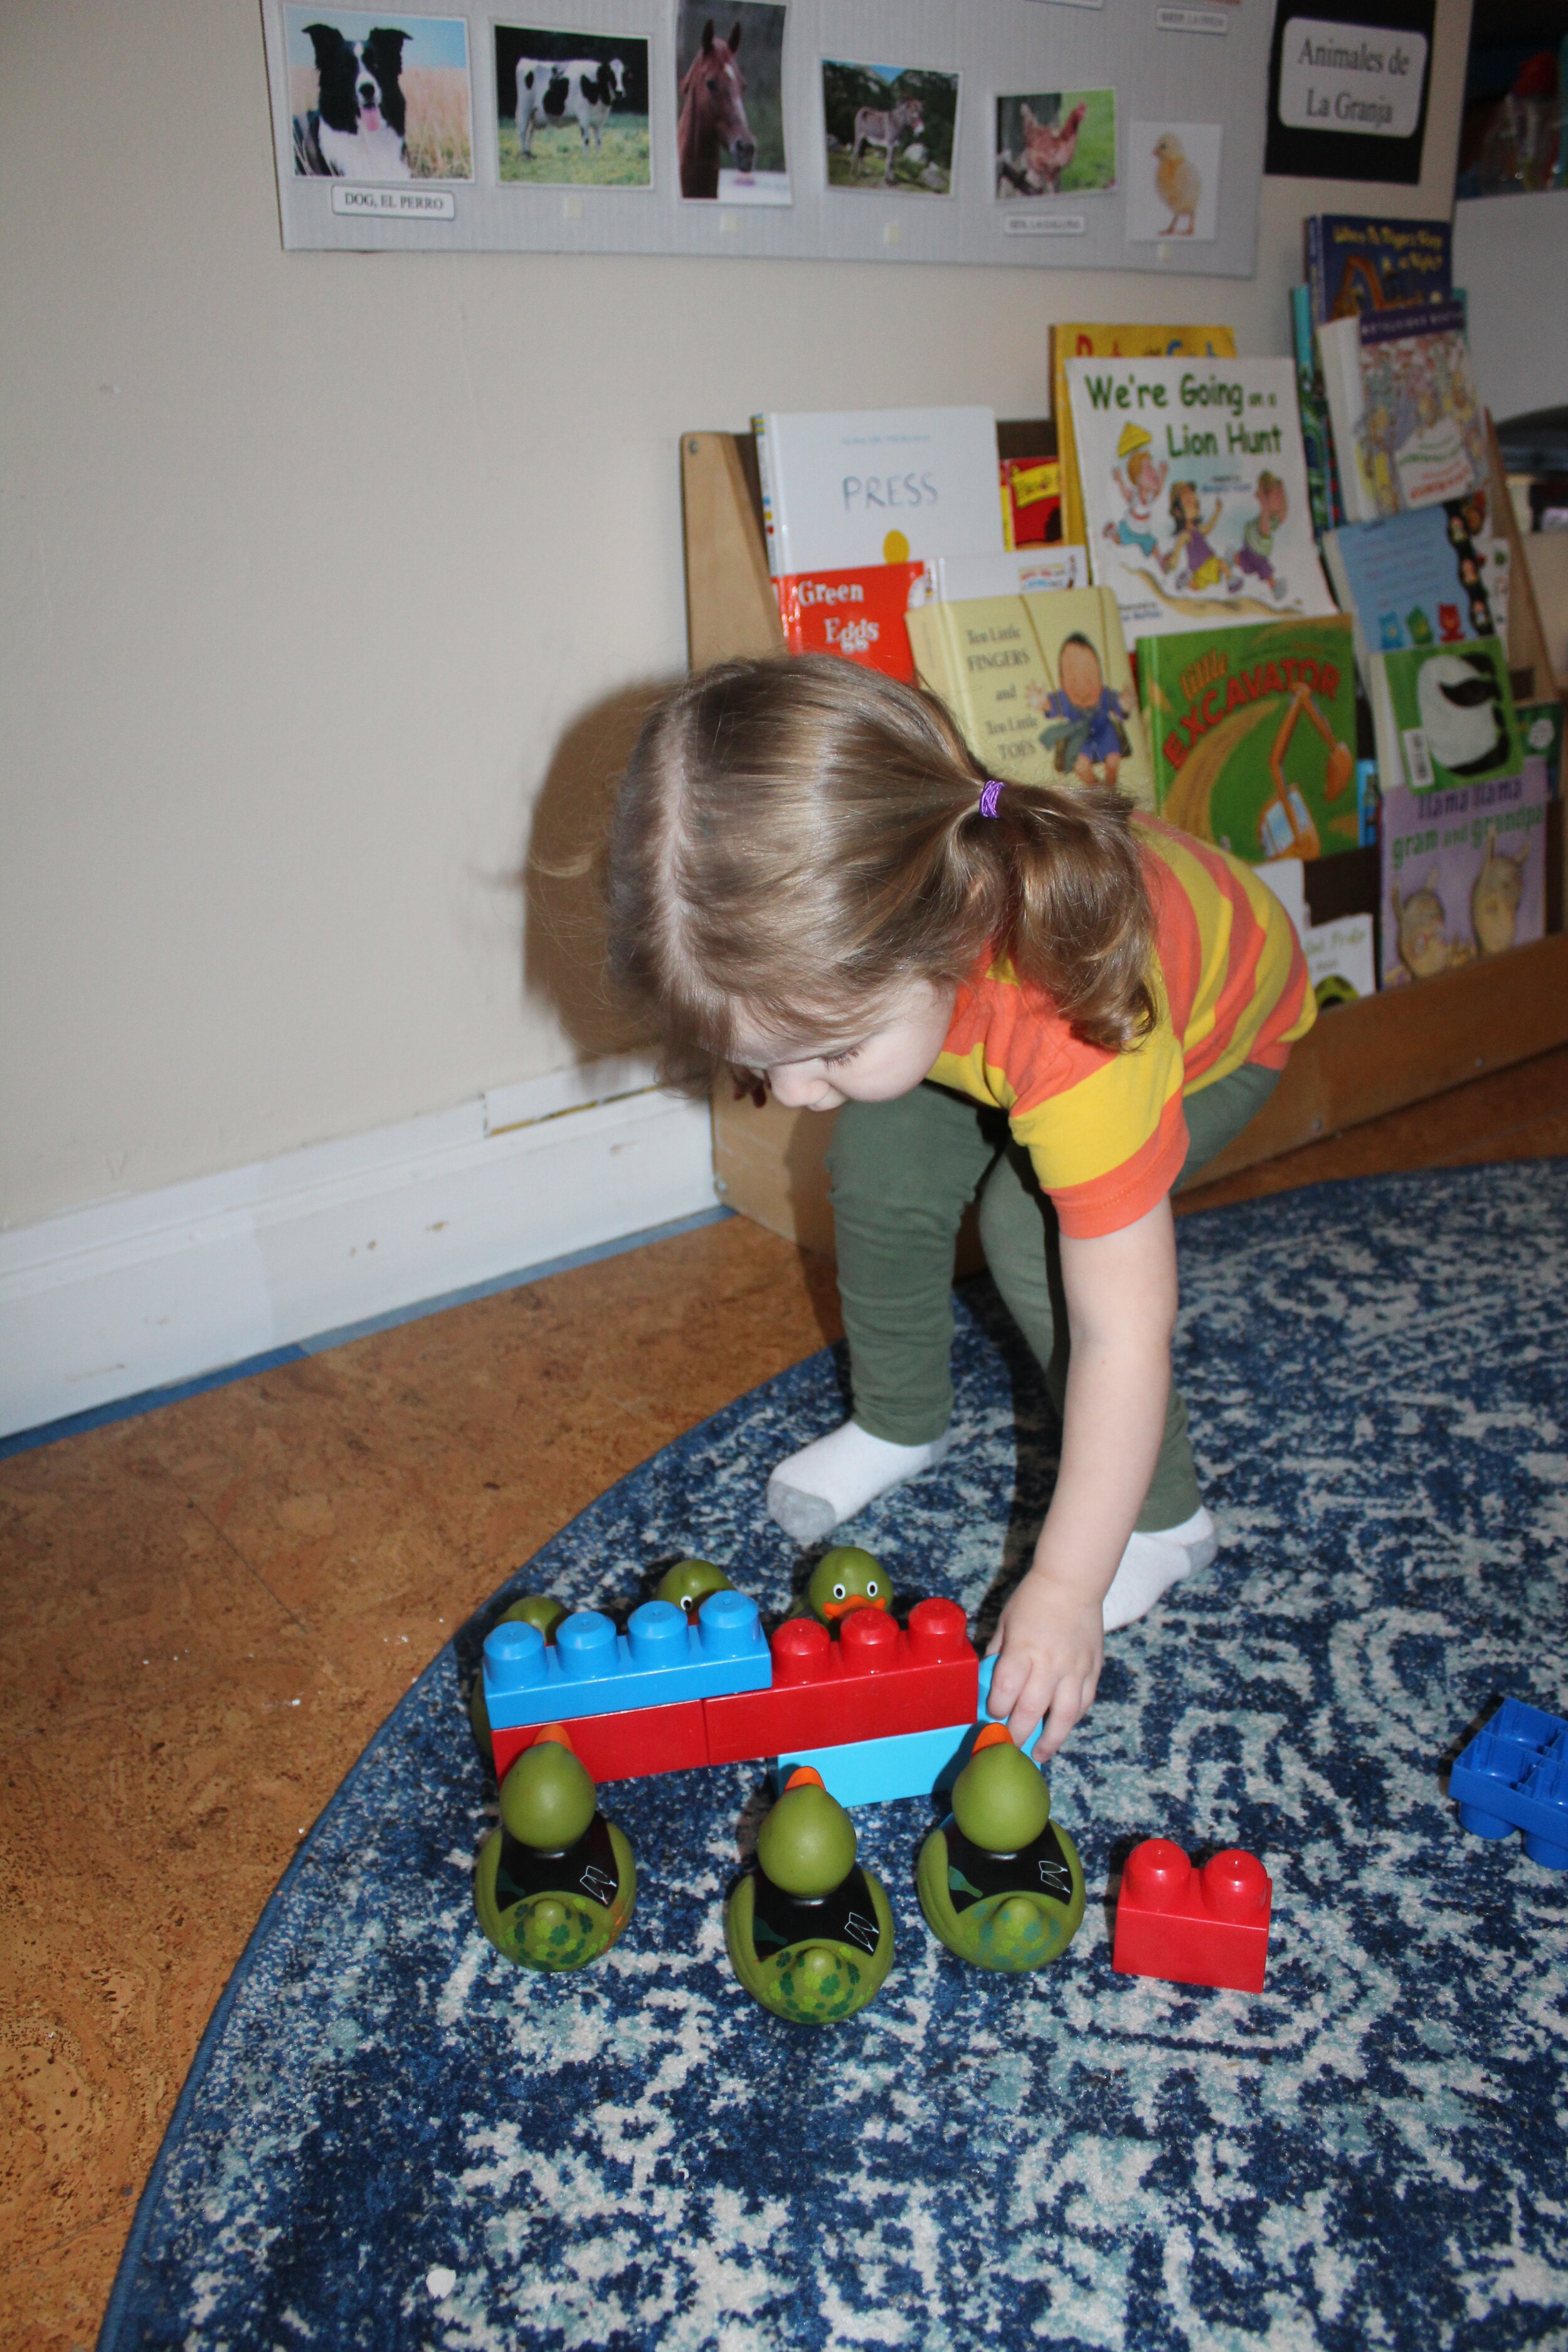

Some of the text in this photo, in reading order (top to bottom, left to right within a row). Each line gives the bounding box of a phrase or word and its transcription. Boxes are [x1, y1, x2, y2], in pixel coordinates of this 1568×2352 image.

[1298, 36, 1410, 75] Animales de
[1306, 87, 1393, 128] La Granja
[344, 192, 443, 211] DOG, EL PERRO
[1084, 373, 1168, 411] We're
[1180, 373, 1244, 417] Going
[1165, 422, 1282, 458] Lion Hunt
[843, 472, 938, 511] PRESS
[798, 580, 864, 607] Green
[824, 617, 880, 654] Eggs
[967, 623, 1021, 644] Ten Little
[967, 648, 1030, 672] FINGERS
[996, 682, 1017, 701] and
[985, 713, 1038, 735] Ten Little
[1163, 658, 1340, 771] EXCAVATOR
[998, 739, 1037, 760] TOES
[1417, 778, 1523, 820] llama llama
[1392, 829, 1439, 871] gram
[1444, 823, 1468, 848] and
